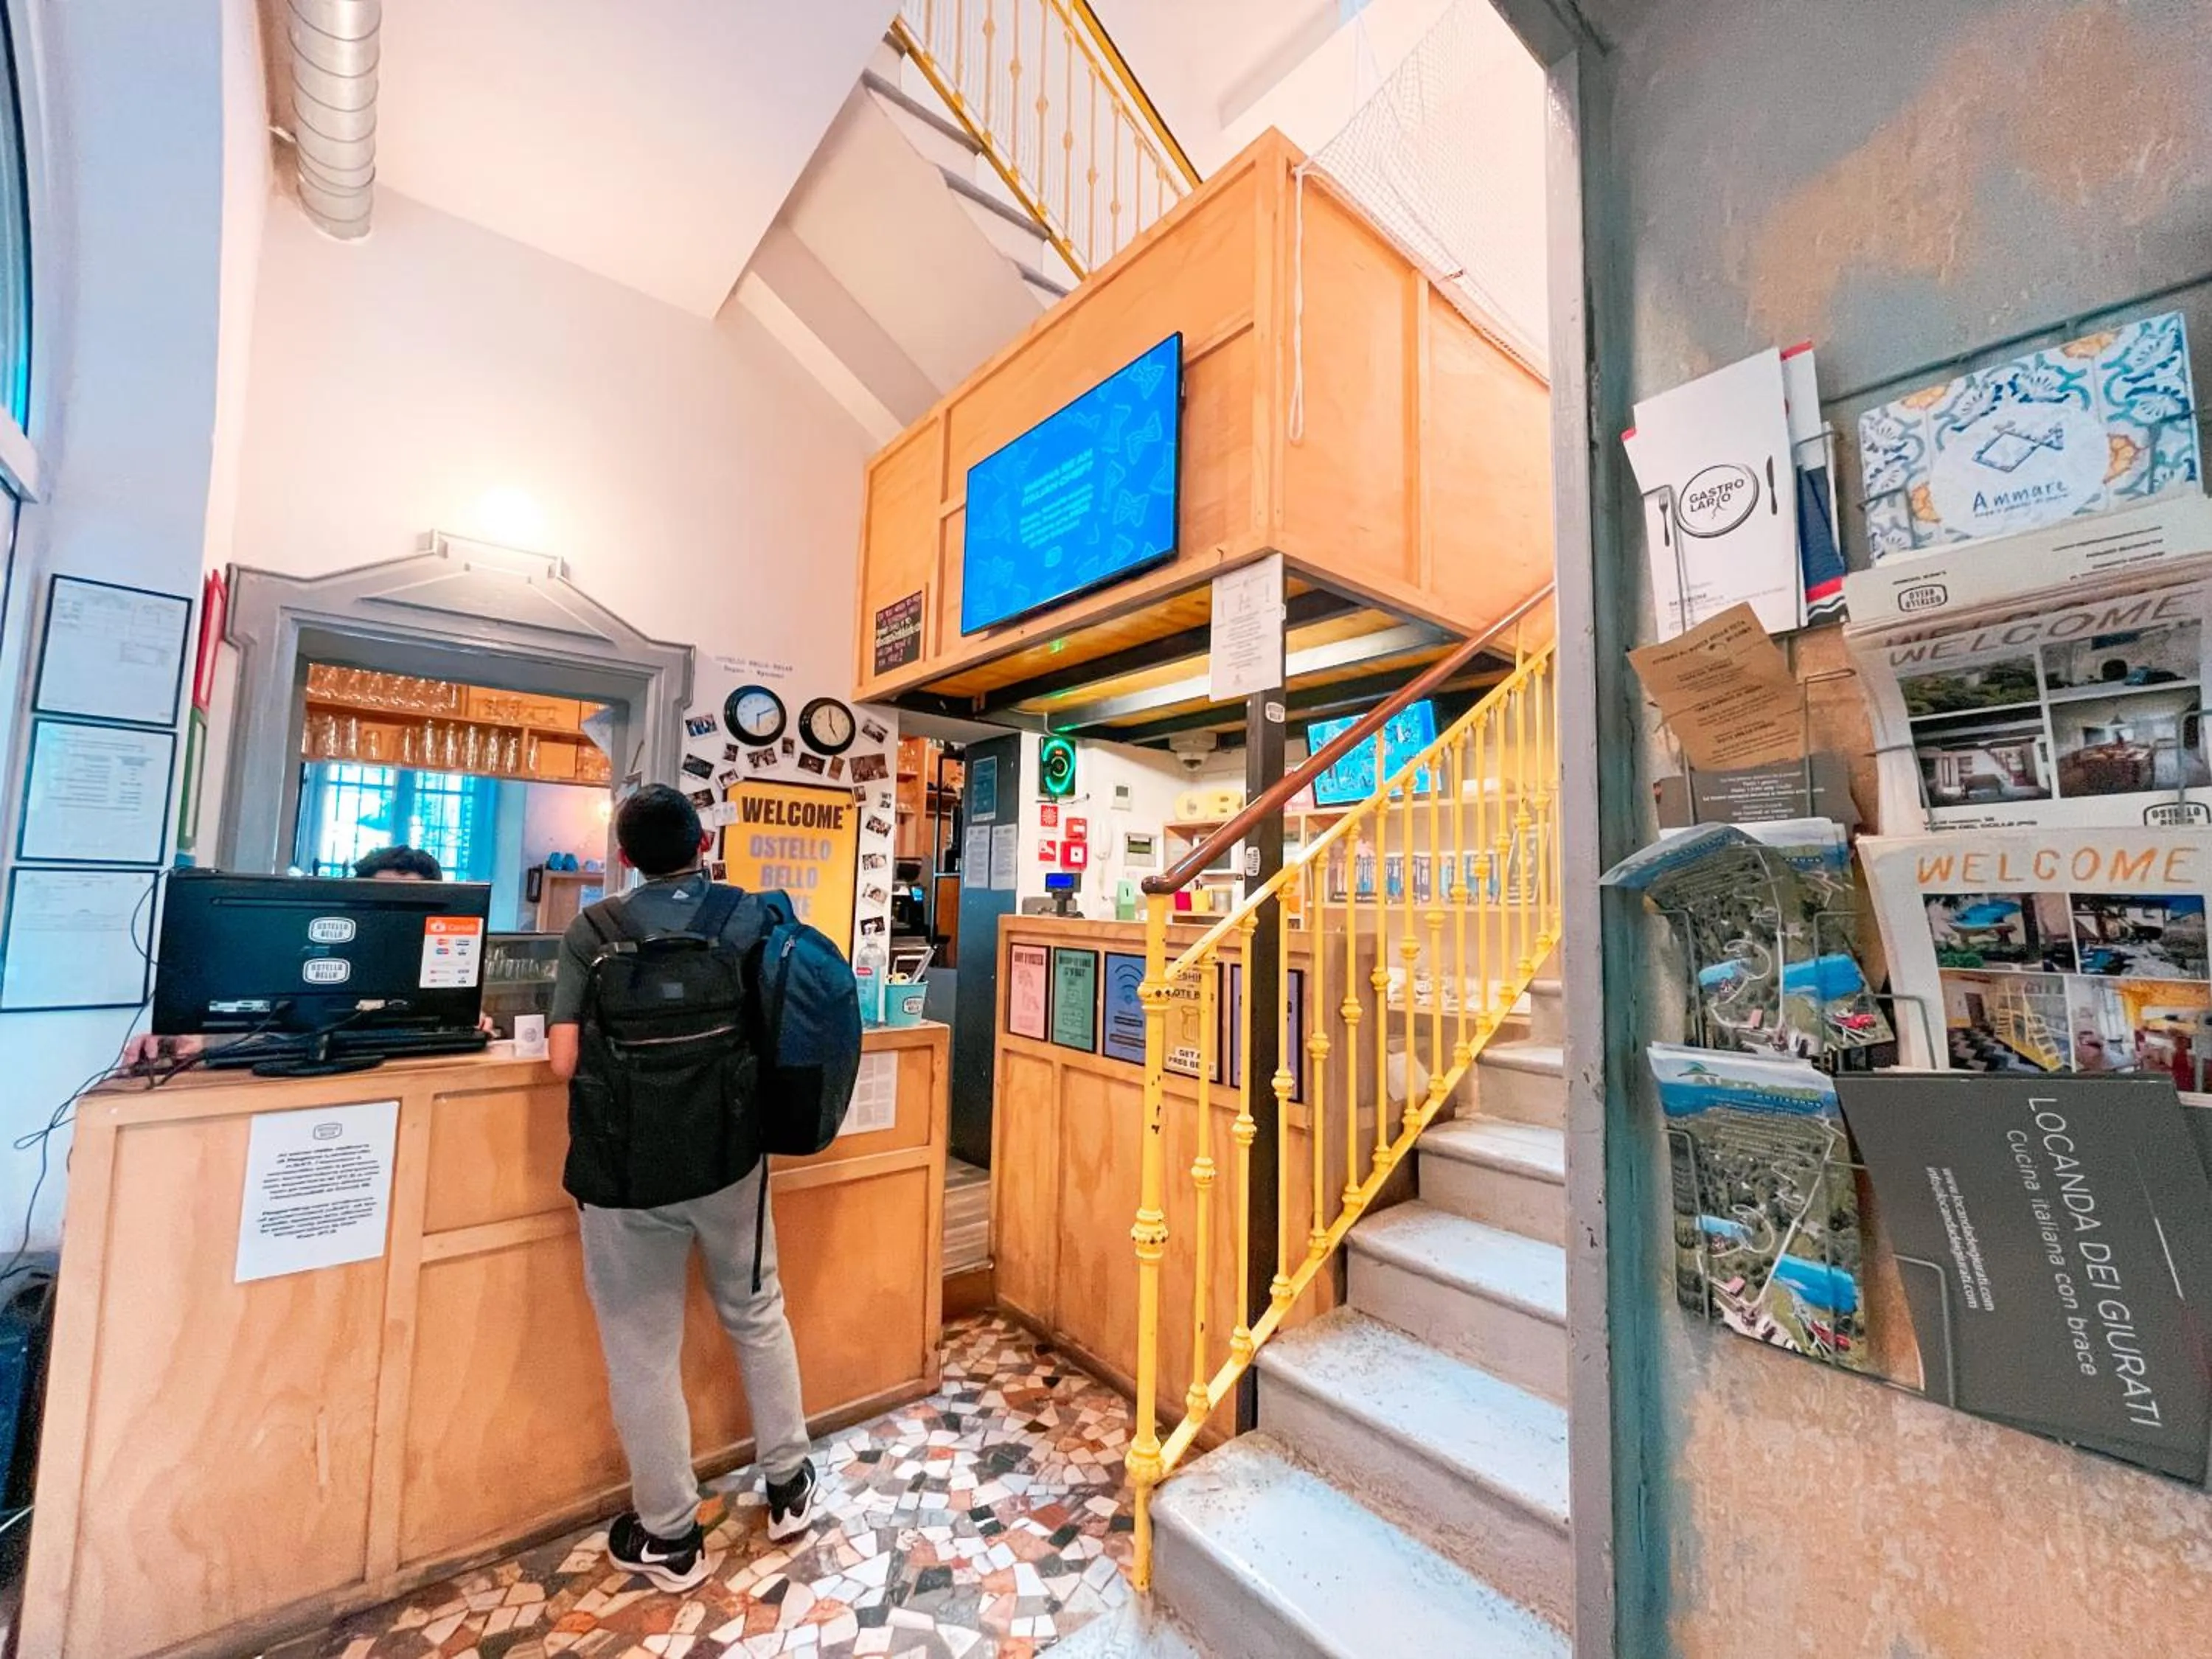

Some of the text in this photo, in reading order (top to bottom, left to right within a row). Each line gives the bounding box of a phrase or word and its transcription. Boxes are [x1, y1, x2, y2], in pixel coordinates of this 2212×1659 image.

[1689, 479, 1744, 504] GASTRO
[1973, 481, 2067, 512] Ammare
[1890, 591, 2204, 667] WELCOME
[742, 796, 844, 830] WELCOME
[750, 835, 832, 860] OSTELLO
[762, 865, 818, 888] BELLO
[1918, 846, 2199, 885] WELCOME
[1179, 1049, 1194, 1058] GET
[2006, 1130, 2097, 1377] Cucina italiana con brace
[2028, 1098, 2163, 1427] LOCANDA DEI GIURATI
